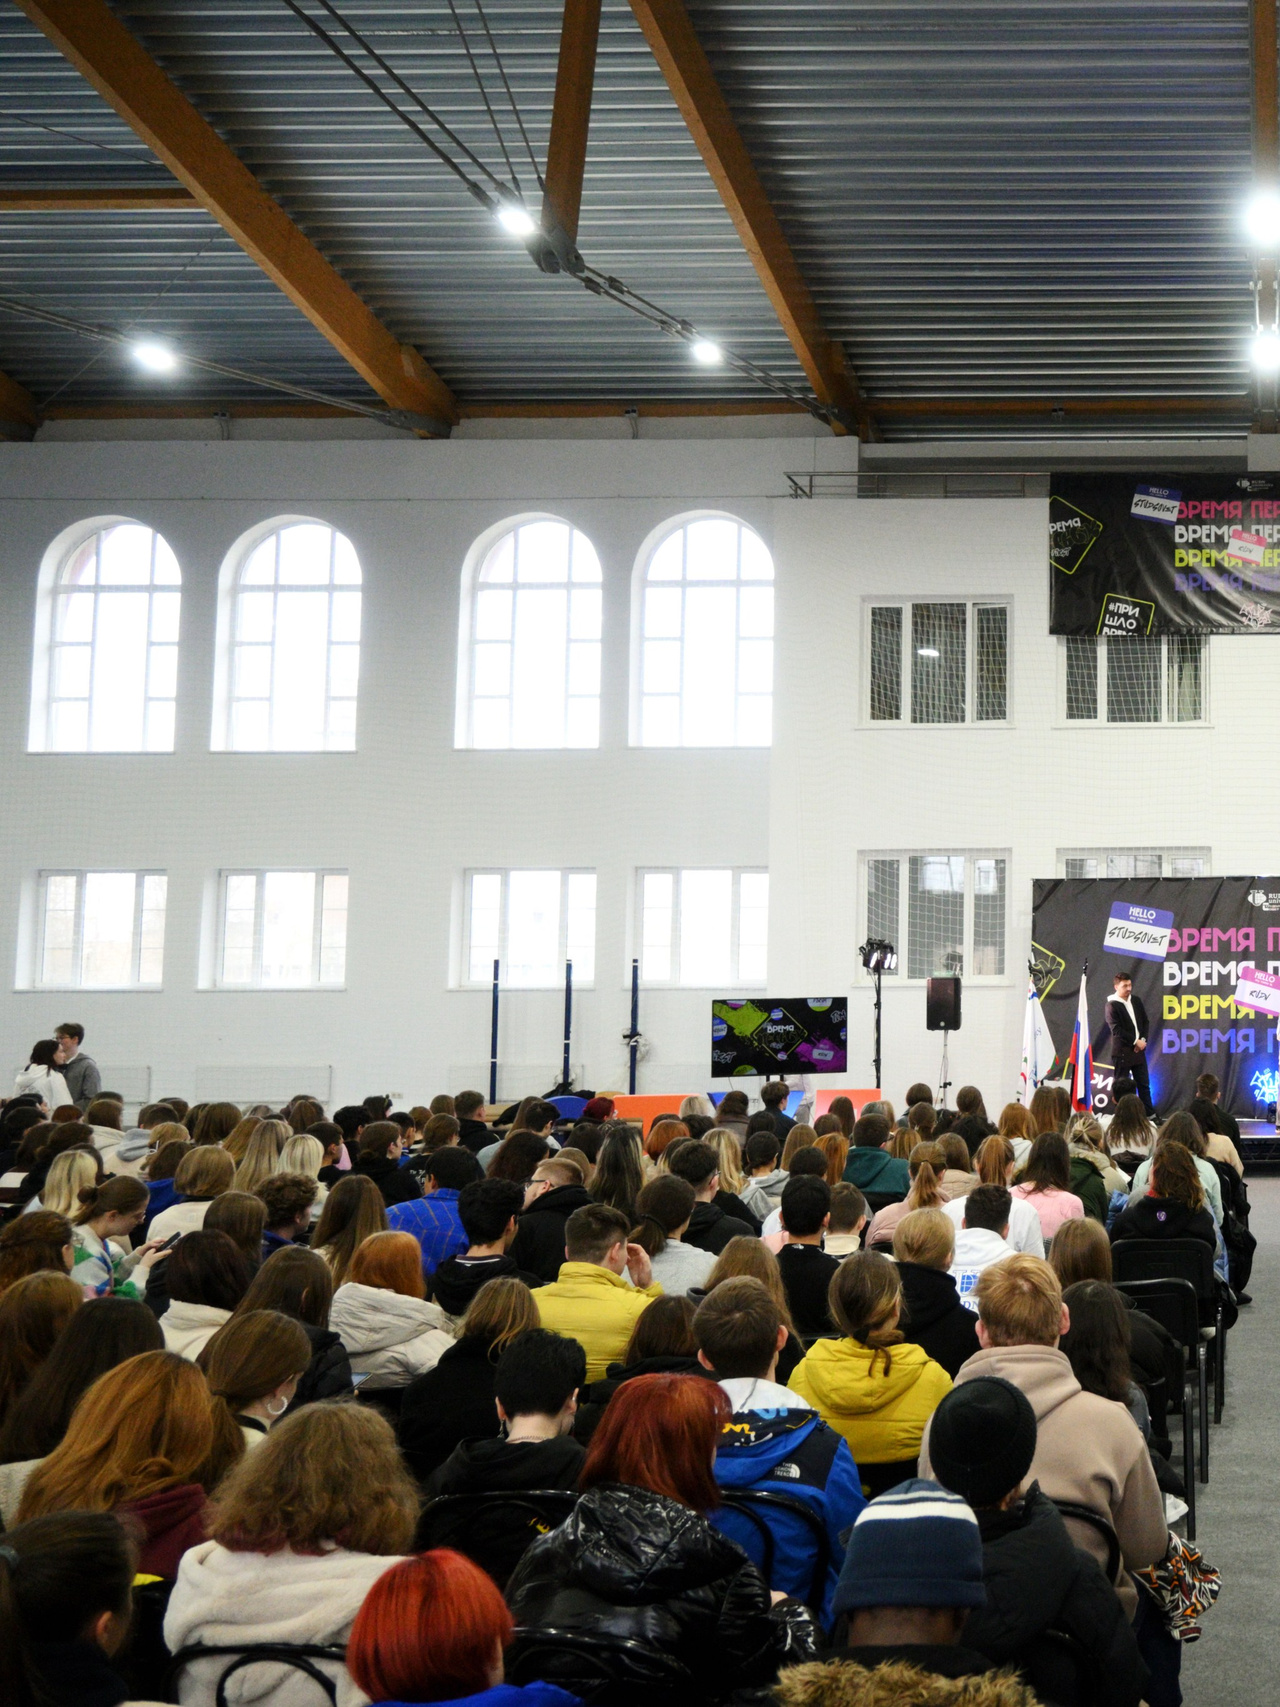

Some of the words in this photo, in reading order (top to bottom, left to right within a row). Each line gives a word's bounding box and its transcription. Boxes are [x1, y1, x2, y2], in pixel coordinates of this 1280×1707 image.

[1149, 487, 1169, 495] HELLO
[1133, 499, 1178, 514] STUDSOVET
[1177, 501, 1242, 519] ВРЕМЯ
[1174, 573, 1242, 592] ВРЕМЯ
[1108, 602, 1140, 618] #ПРИ
[1105, 614, 1137, 629] ШЛО
[1102, 626, 1138, 636] ВРЕ
[1129, 906, 1156, 919] HELLO
[1108, 926, 1168, 946] STUDSOVET
[1167, 927, 1255, 953] ВРЕМЯ
[1254, 971, 1275, 983] HELLO
[1162, 1028, 1255, 1054] ВРЕМЯ
